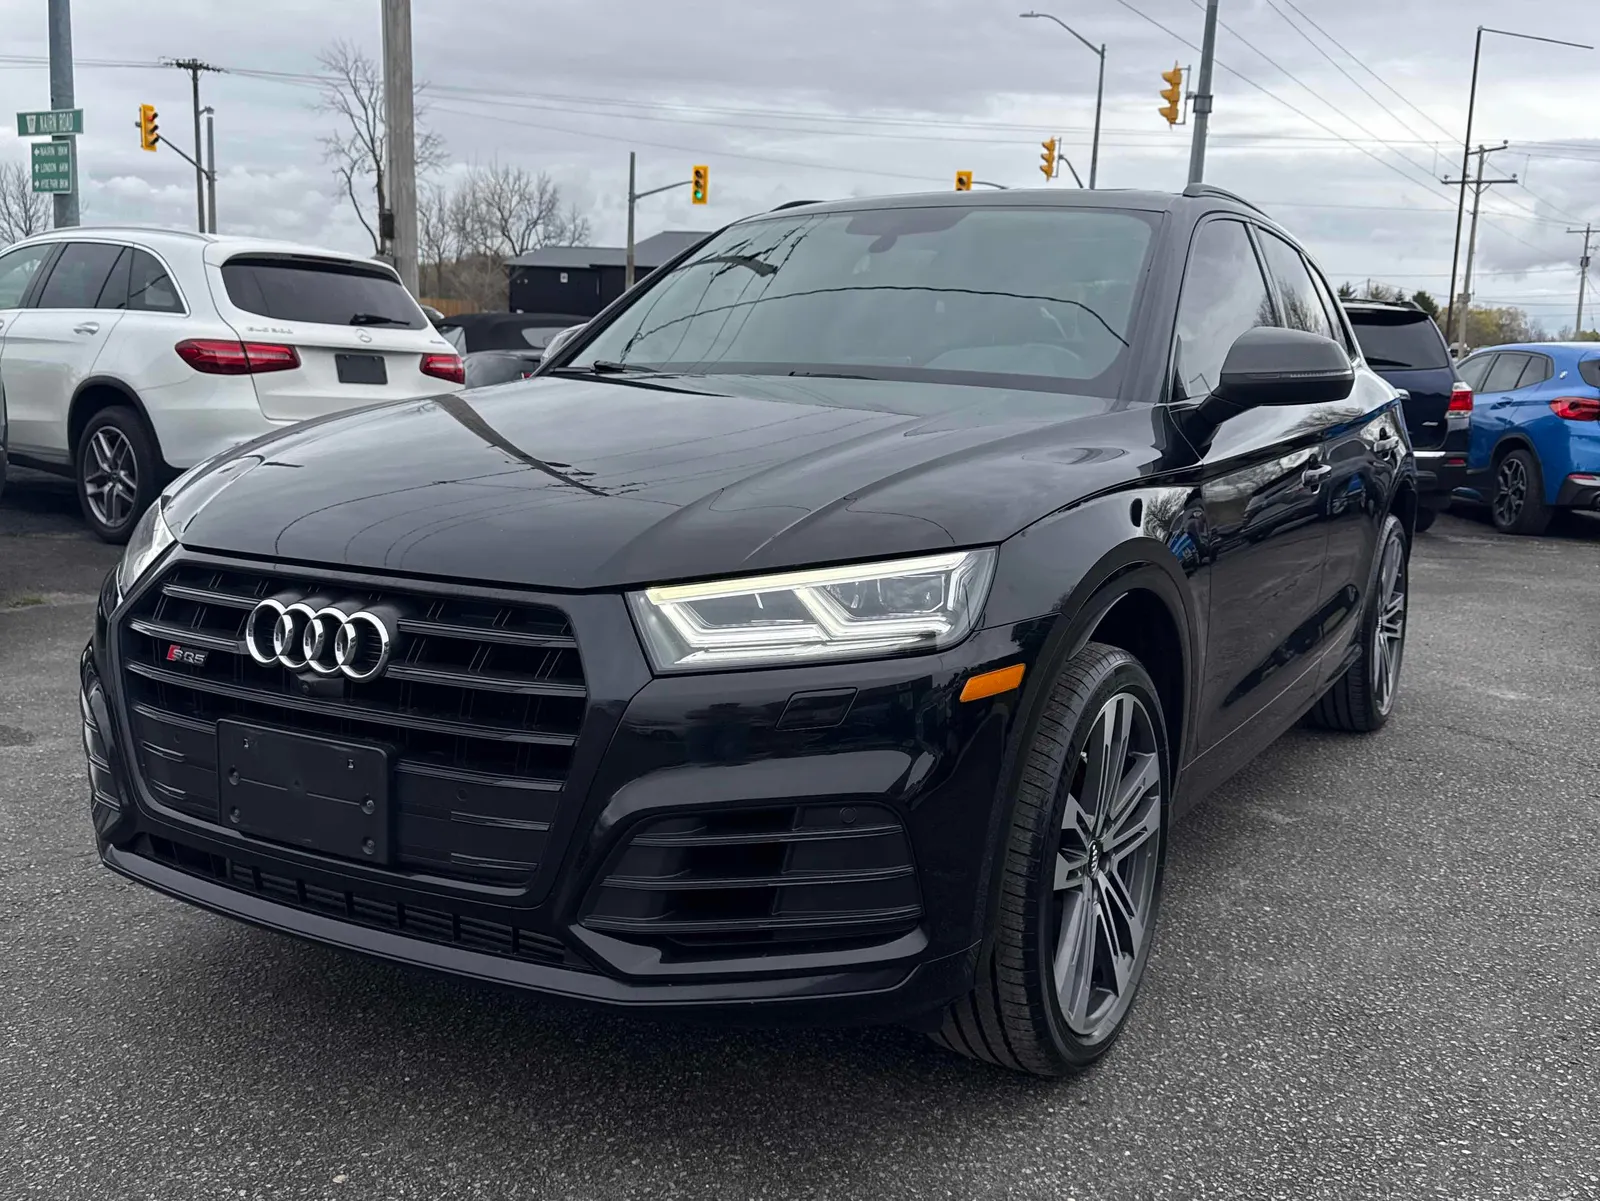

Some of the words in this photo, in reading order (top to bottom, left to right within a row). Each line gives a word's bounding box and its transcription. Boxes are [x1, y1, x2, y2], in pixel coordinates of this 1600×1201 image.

[40, 115, 57, 131] NAIRN
[59, 113, 73, 131] ROAD
[41, 163, 56, 173] LONDON
[169, 647, 206, 664] SQ5
